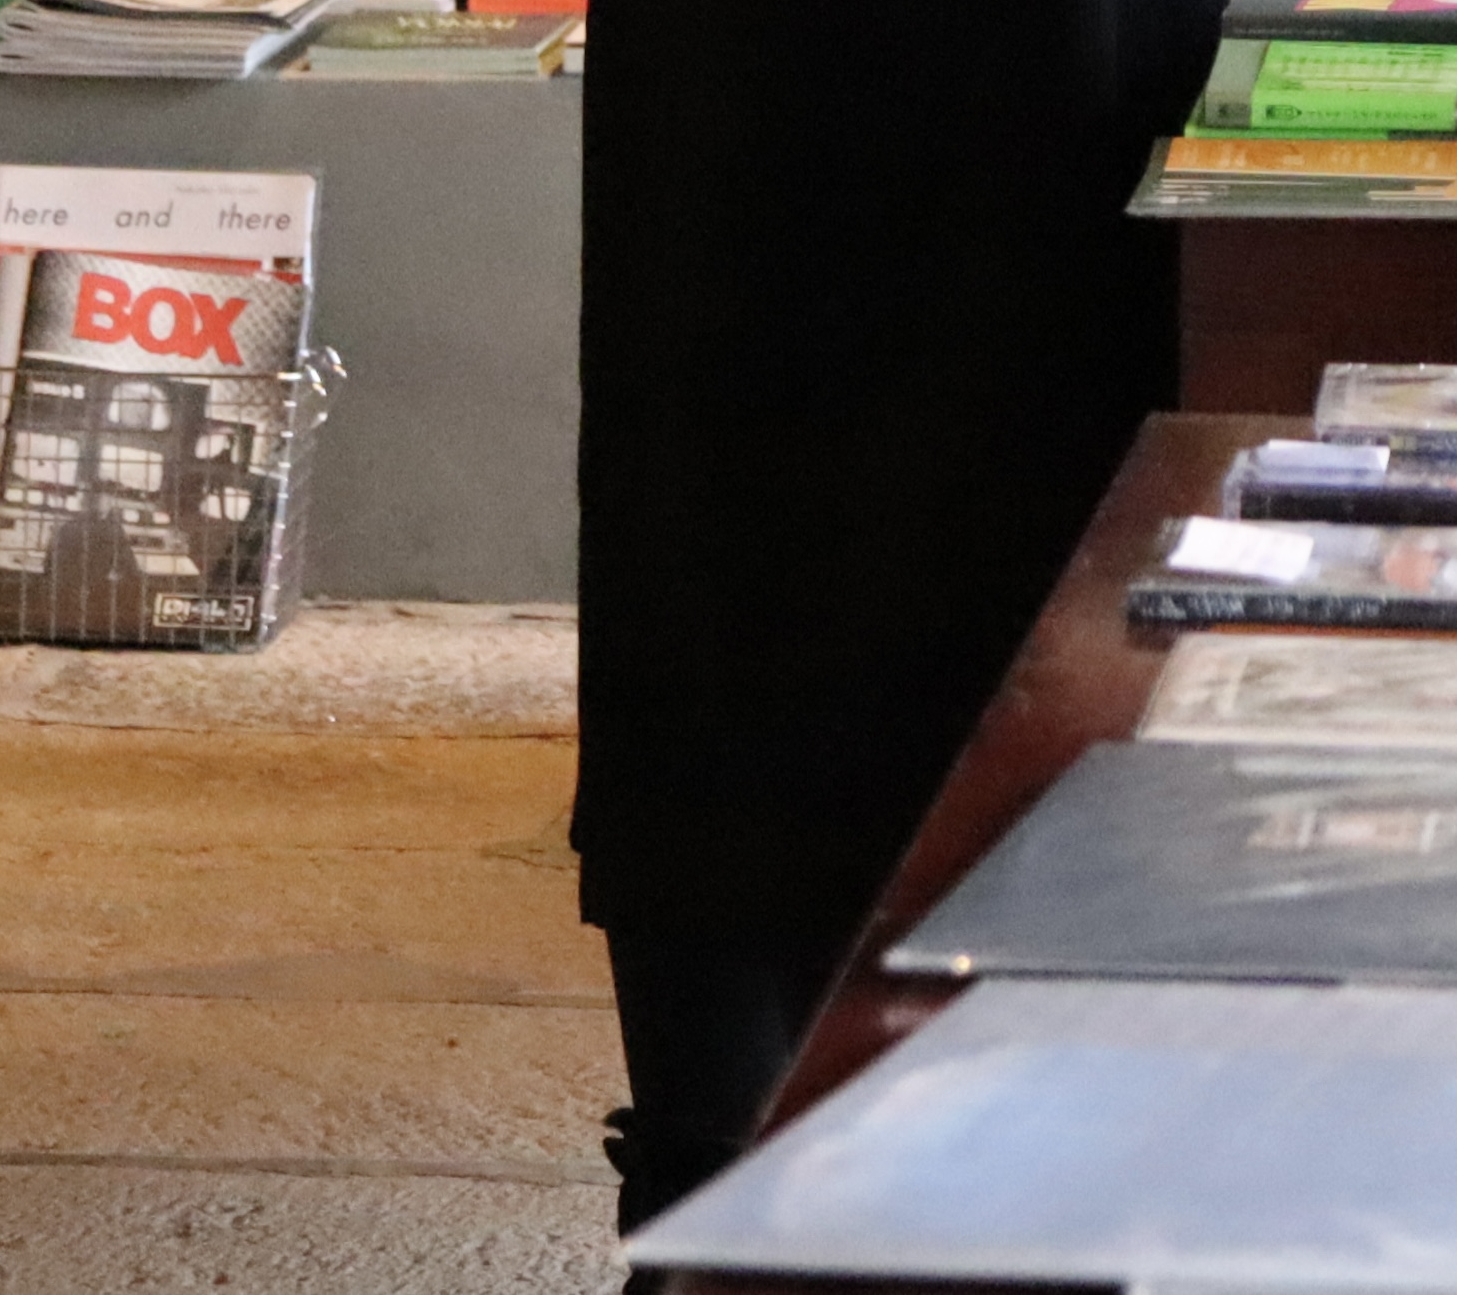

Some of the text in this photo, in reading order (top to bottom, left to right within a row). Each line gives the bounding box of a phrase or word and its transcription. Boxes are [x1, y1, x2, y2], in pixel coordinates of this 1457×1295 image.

[3, 198, 292, 232] here and there
[71, 271, 250, 367] BOX
